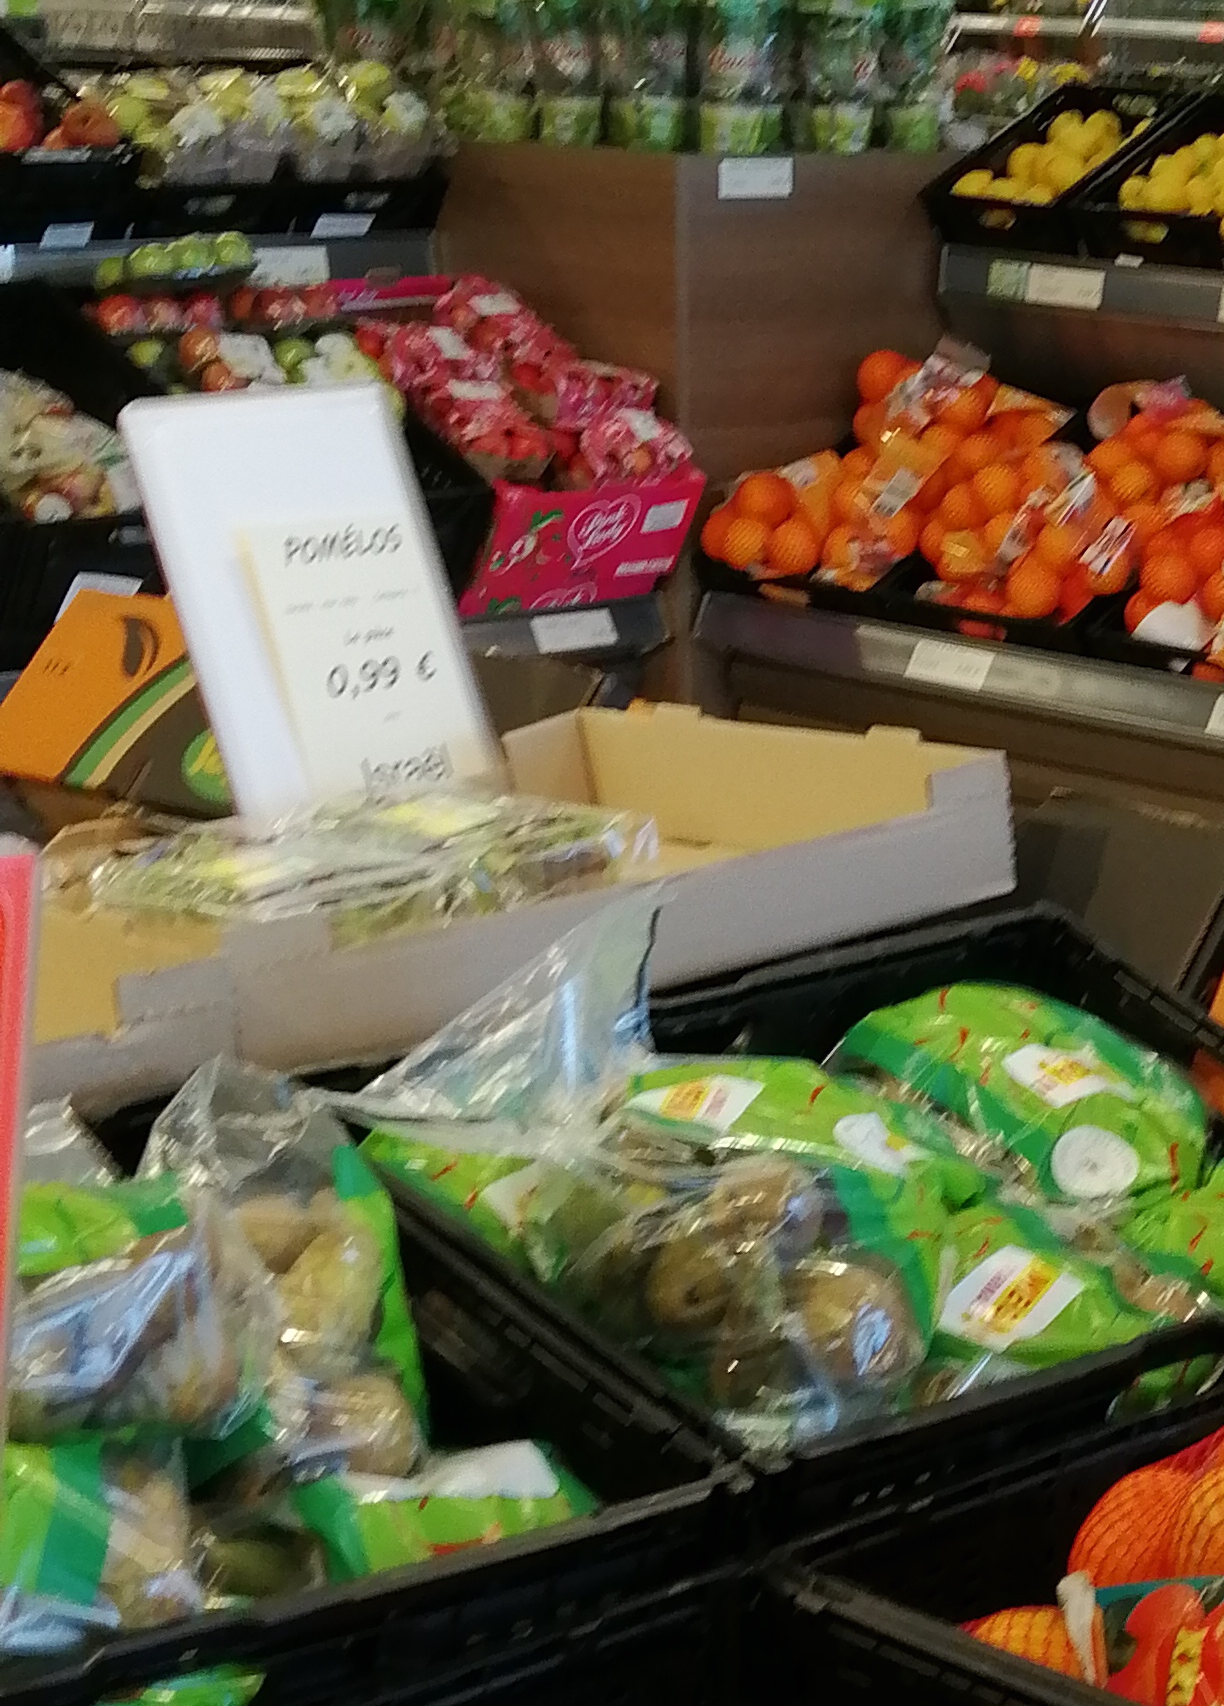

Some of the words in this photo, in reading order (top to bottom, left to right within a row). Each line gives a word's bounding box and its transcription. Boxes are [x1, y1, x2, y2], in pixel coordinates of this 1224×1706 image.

[283, 523, 403, 568] POMÉLOS
[326, 655, 401, 700] 0,99
[415, 649, 438, 683] €
